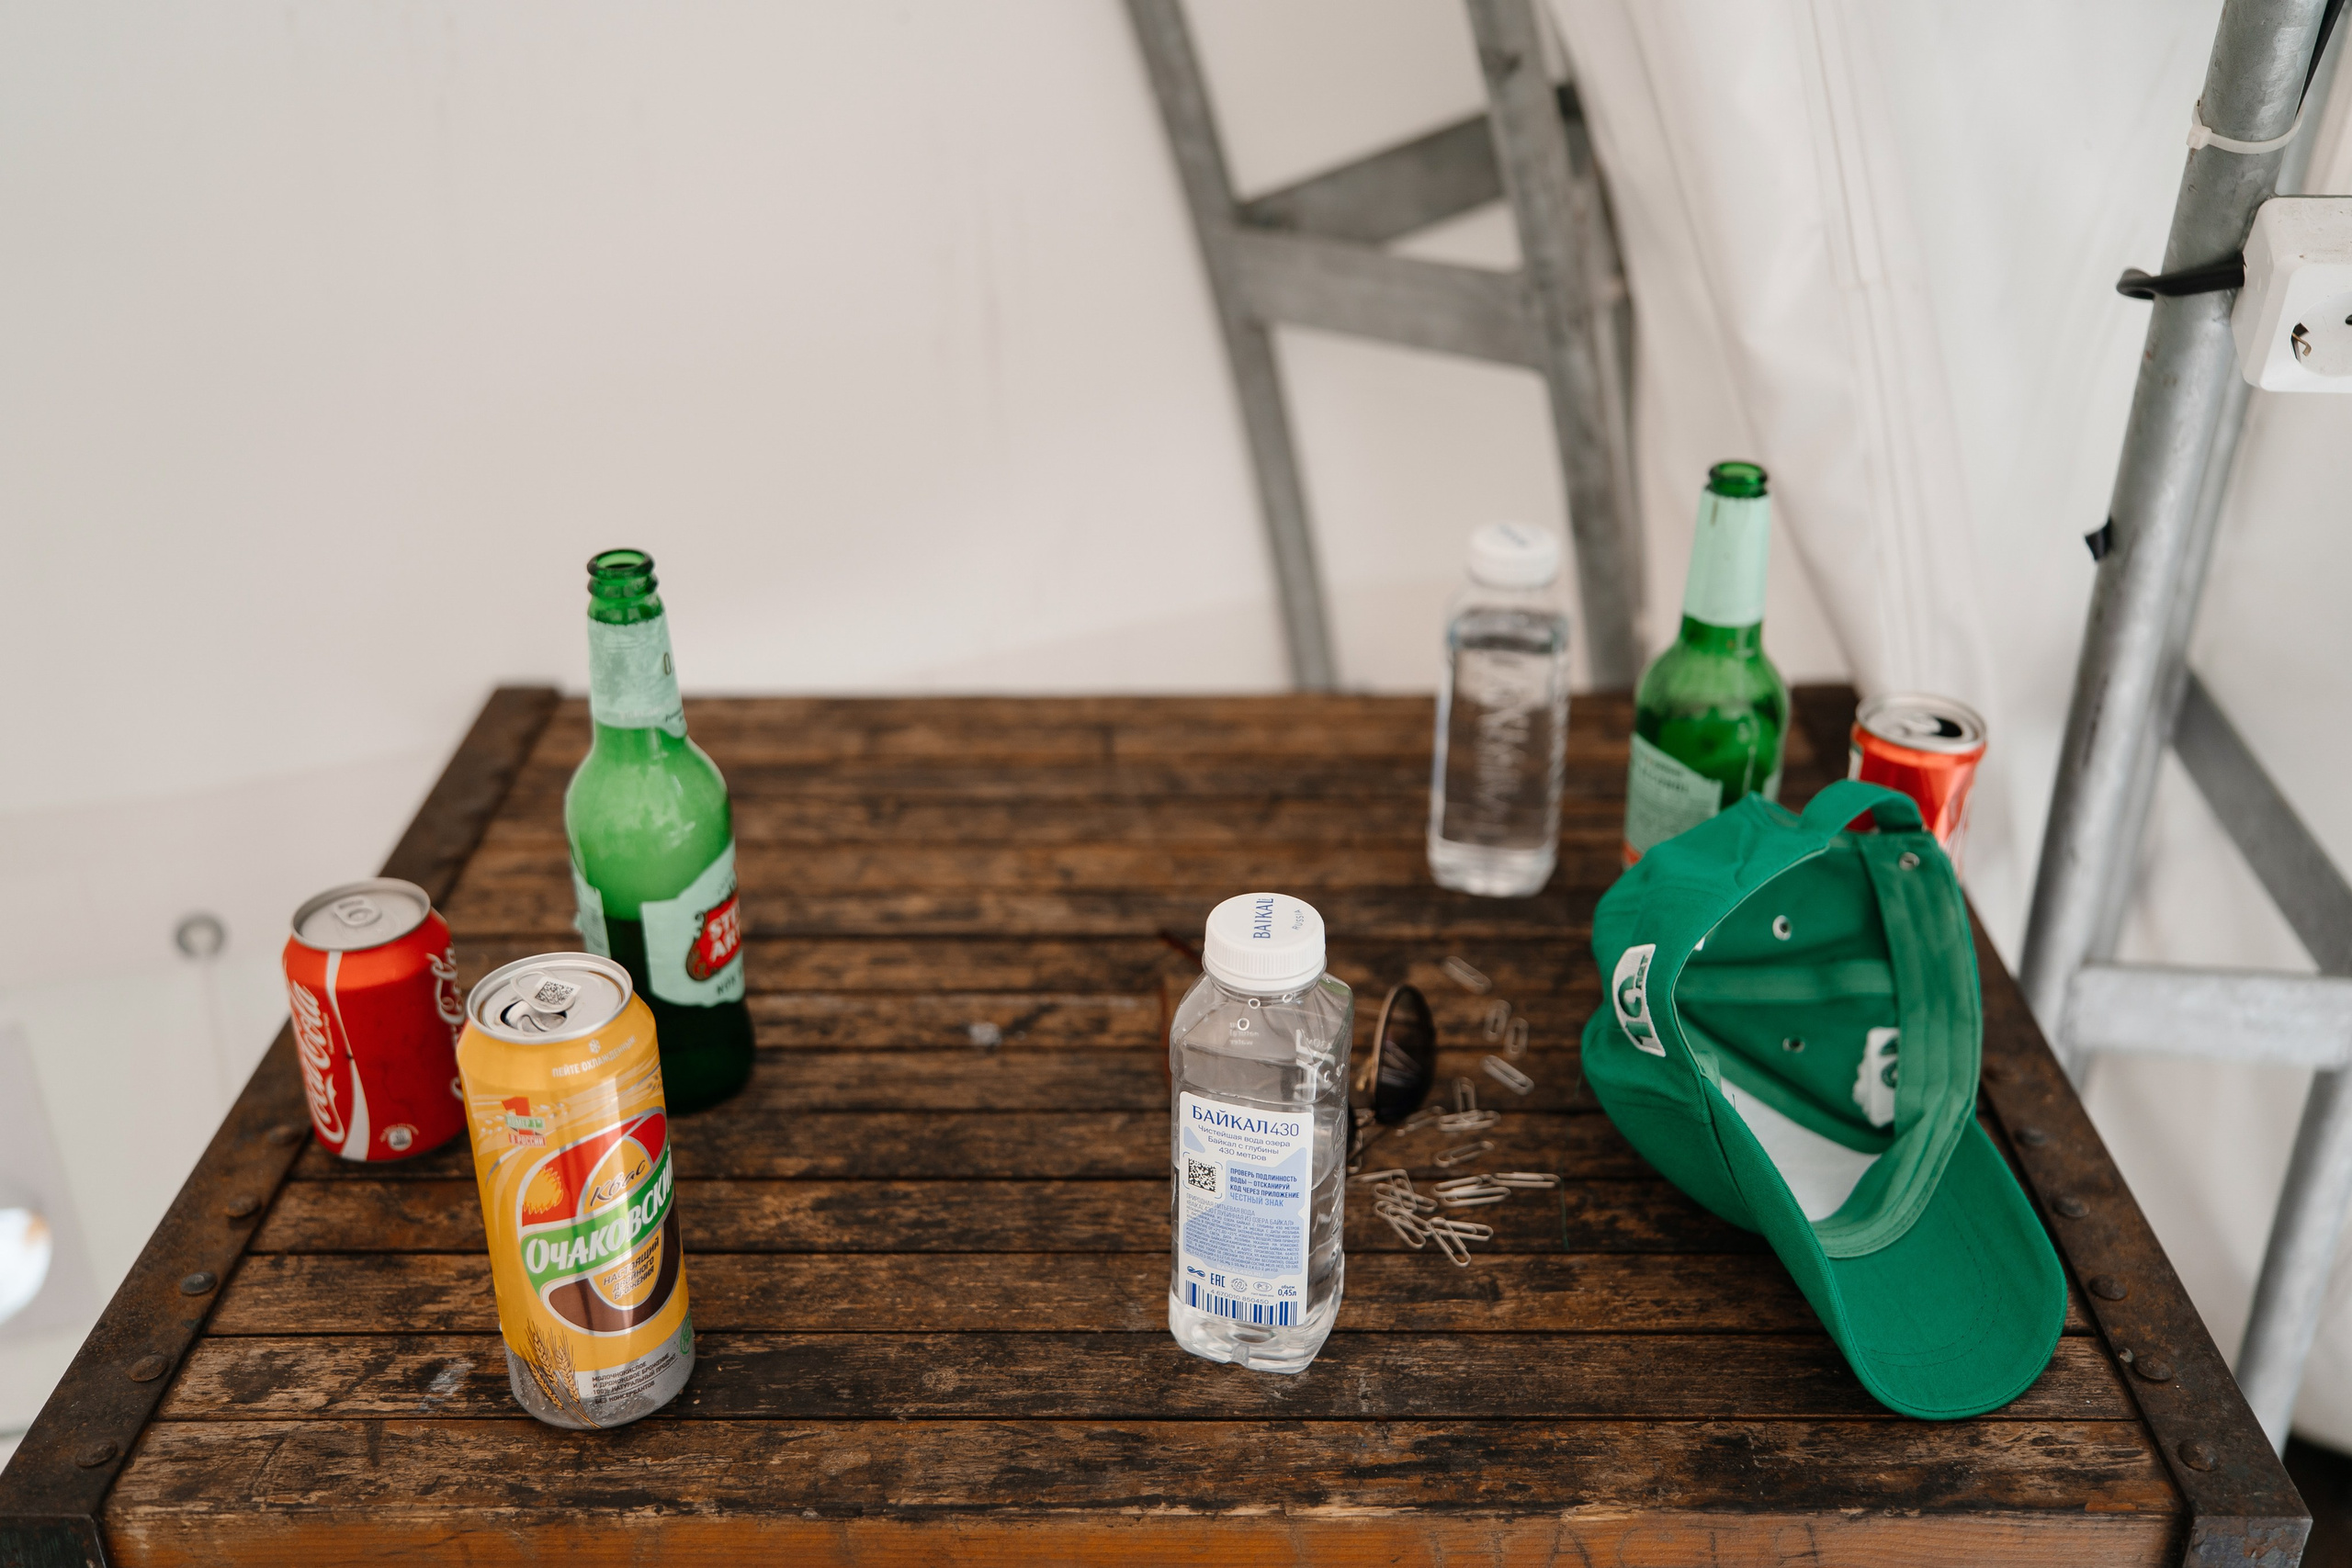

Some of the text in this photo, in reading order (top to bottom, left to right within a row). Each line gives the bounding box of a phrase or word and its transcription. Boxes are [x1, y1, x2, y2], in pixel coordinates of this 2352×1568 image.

[552, 1063, 581, 1077] ПЕЙТЕ
[517, 1134, 544, 1146] РОССИИ
[1198, 1124, 1242, 1141] Чистейшая
[1244, 1135, 1264, 1145] вода
[1208, 1135, 1237, 1148] Байкал
[1245, 1145, 1279, 1155] глубины
[1219, 1146, 1267, 1161] 430 метров
[590, 1159, 646, 1207] Квас
[1230, 1168, 1297, 1182] ПРОВЕРЬ ПОДЛИННОСТЬ
[1230, 1176, 1290, 1190] ВОДЫ ОТСКАНИРУЙ
[1230, 1184, 1241, 1192] КОД
[1243, 1187, 1260, 1195] ЧЕРЕЗ
[1230, 1192, 1284, 1207] ЧЕСТНЫЙ ЗНАК
[604, 1235, 660, 1286] НАСТОЯЩИЙ
[613, 1257, 654, 1293] ДВОЙНОГО
[614, 1265, 654, 1300] БРОЖЕНИЯ
[1241, 1295, 1269, 1304] 850450
[593, 1361, 647, 1382] МОЛОЧНОКИСЛОЕ
[641, 1352, 670, 1374] БРОЖЕНИЕ
[610, 1369, 656, 1393] НАТУРАЛЬНЫЙ
[609, 1380, 656, 1403] КОНСЕРВАНТОВ
